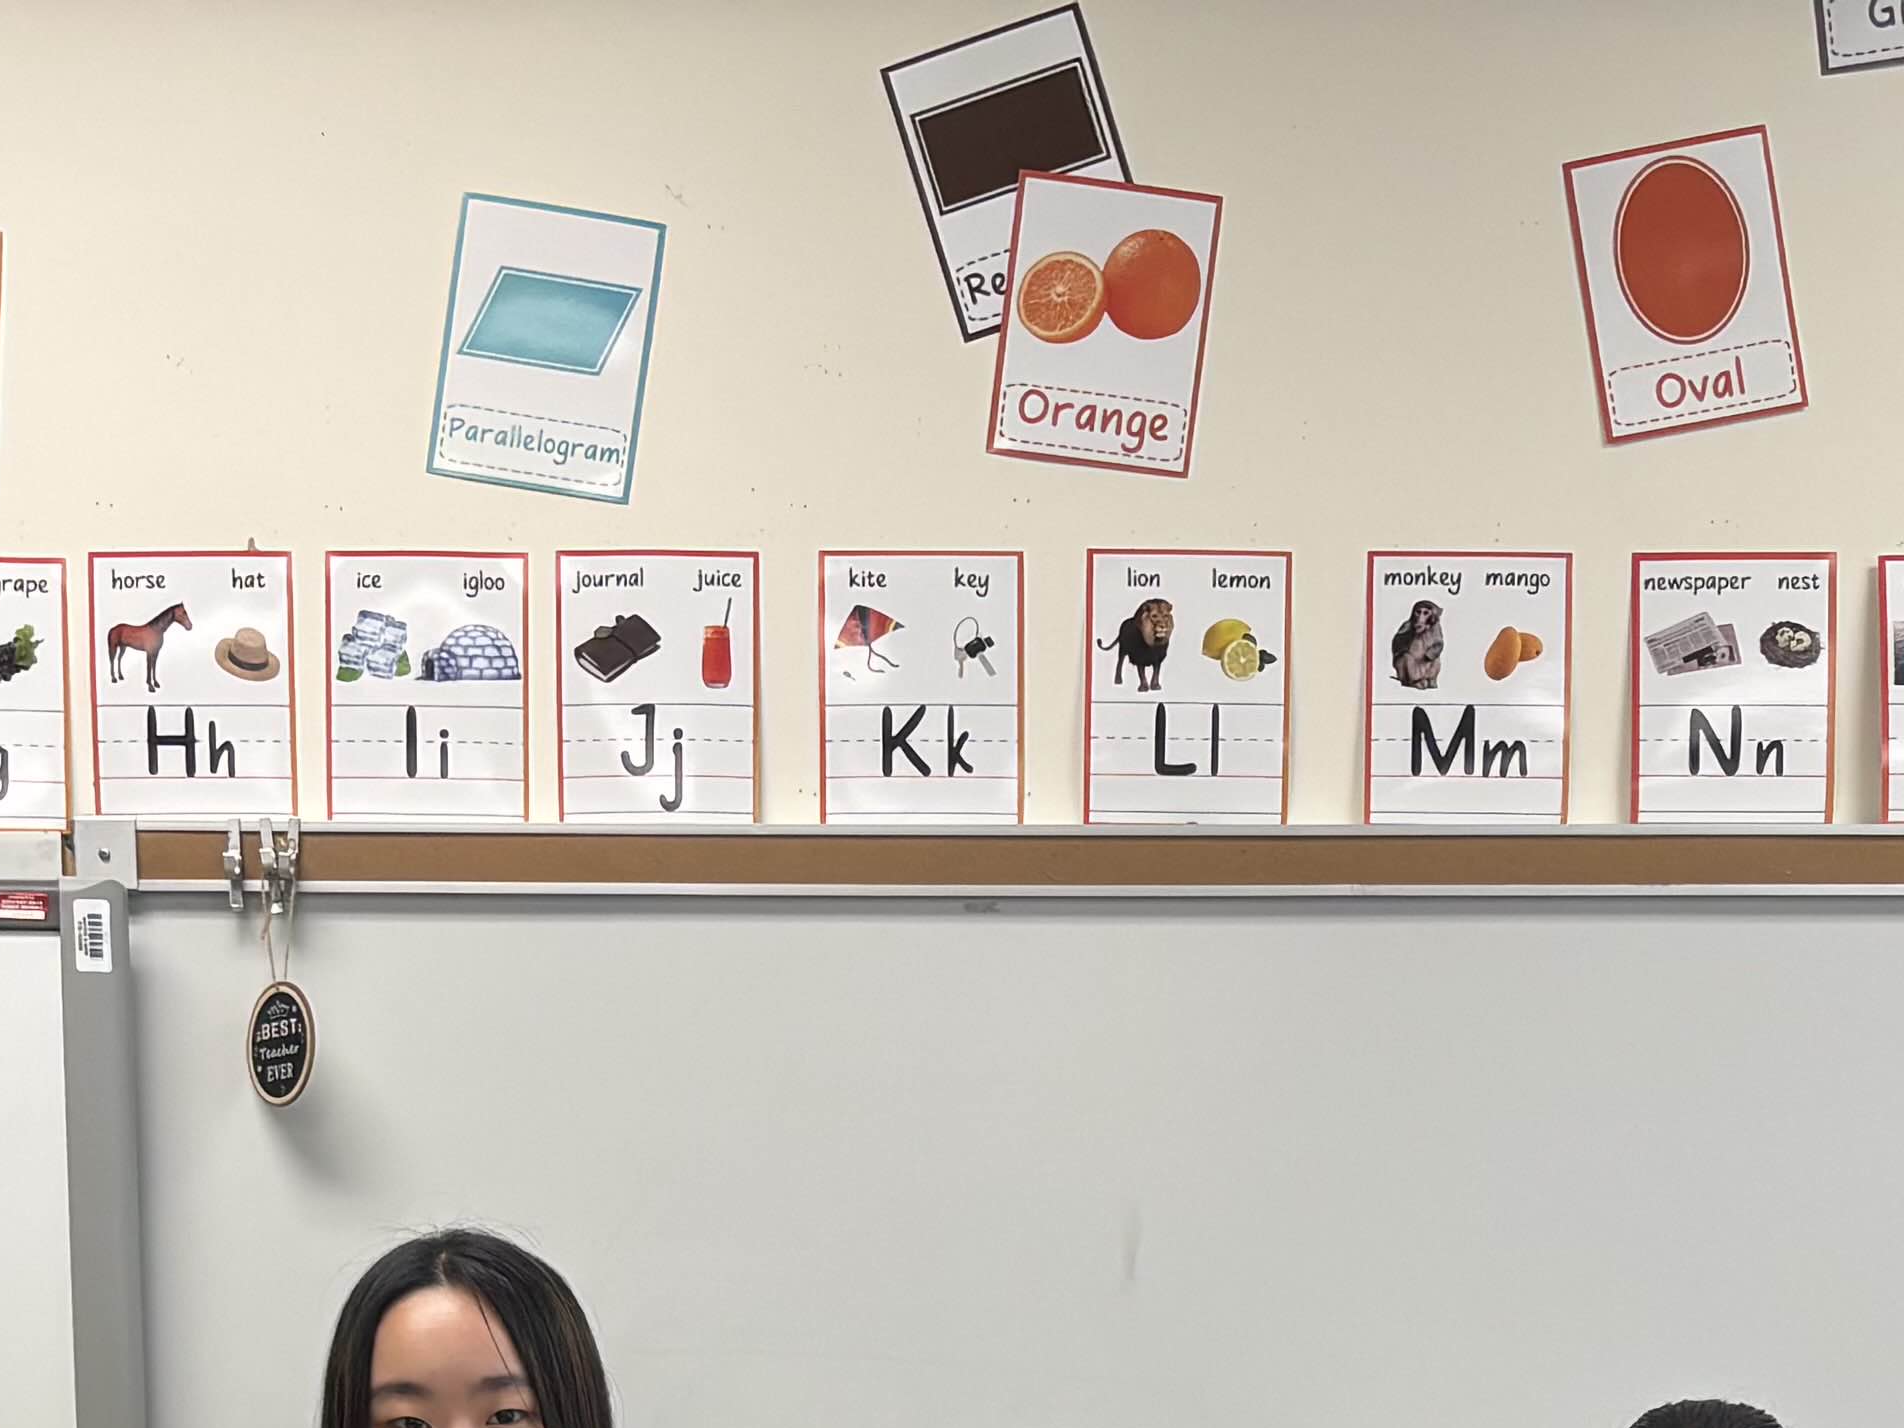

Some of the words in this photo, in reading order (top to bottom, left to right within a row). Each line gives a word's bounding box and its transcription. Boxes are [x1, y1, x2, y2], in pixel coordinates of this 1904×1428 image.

[1656, 350, 1748, 413] Oval
[1019, 385, 1168, 457] Orange
[448, 414, 621, 469] Parallelogram
[112, 569, 166, 590] horse
[232, 568, 265, 589] hat
[357, 572, 381, 588] ice
[464, 570, 505, 598] igloo
[572, 567, 643, 594] journal
[693, 569, 741, 592] juice
[849, 568, 887, 587] kite
[955, 567, 989, 597] key
[1128, 567, 1160, 587] lion
[1213, 568, 1270, 589] lemon
[1384, 565, 1461, 595] monkey
[1485, 572, 1550, 595] mango
[1644, 576, 1751, 595] newspaper
[1778, 574, 1819, 590] nest
[261, 1018, 297, 1040] BEST
[259, 1043, 299, 1060] Teacher
[266, 1062, 294, 1082] EVER
